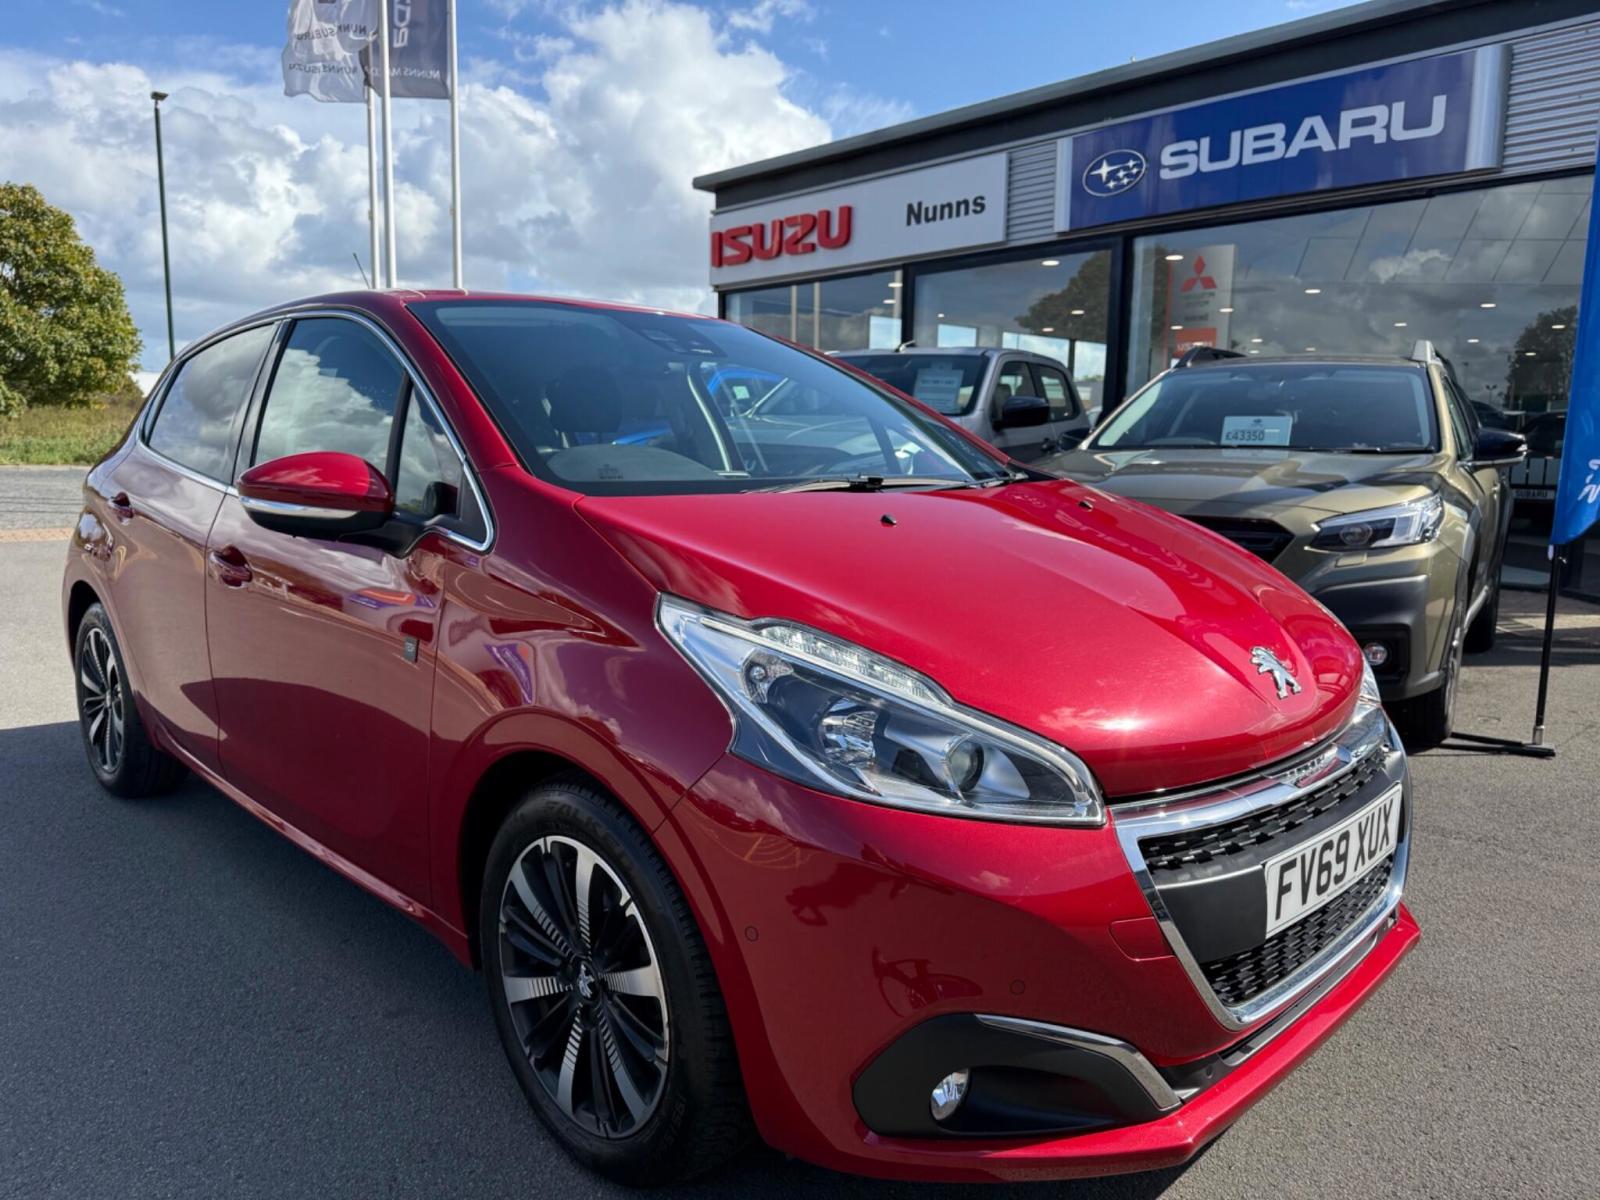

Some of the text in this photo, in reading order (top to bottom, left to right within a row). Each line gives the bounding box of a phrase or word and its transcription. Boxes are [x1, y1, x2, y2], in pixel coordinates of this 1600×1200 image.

[1160, 95, 1447, 181] SUBARU
[711, 205, 852, 268] ISUZU
[906, 195, 986, 227] Nunns
[1225, 430, 1265, 441] £43350
[1275, 798, 1395, 922] FV69 XUX
